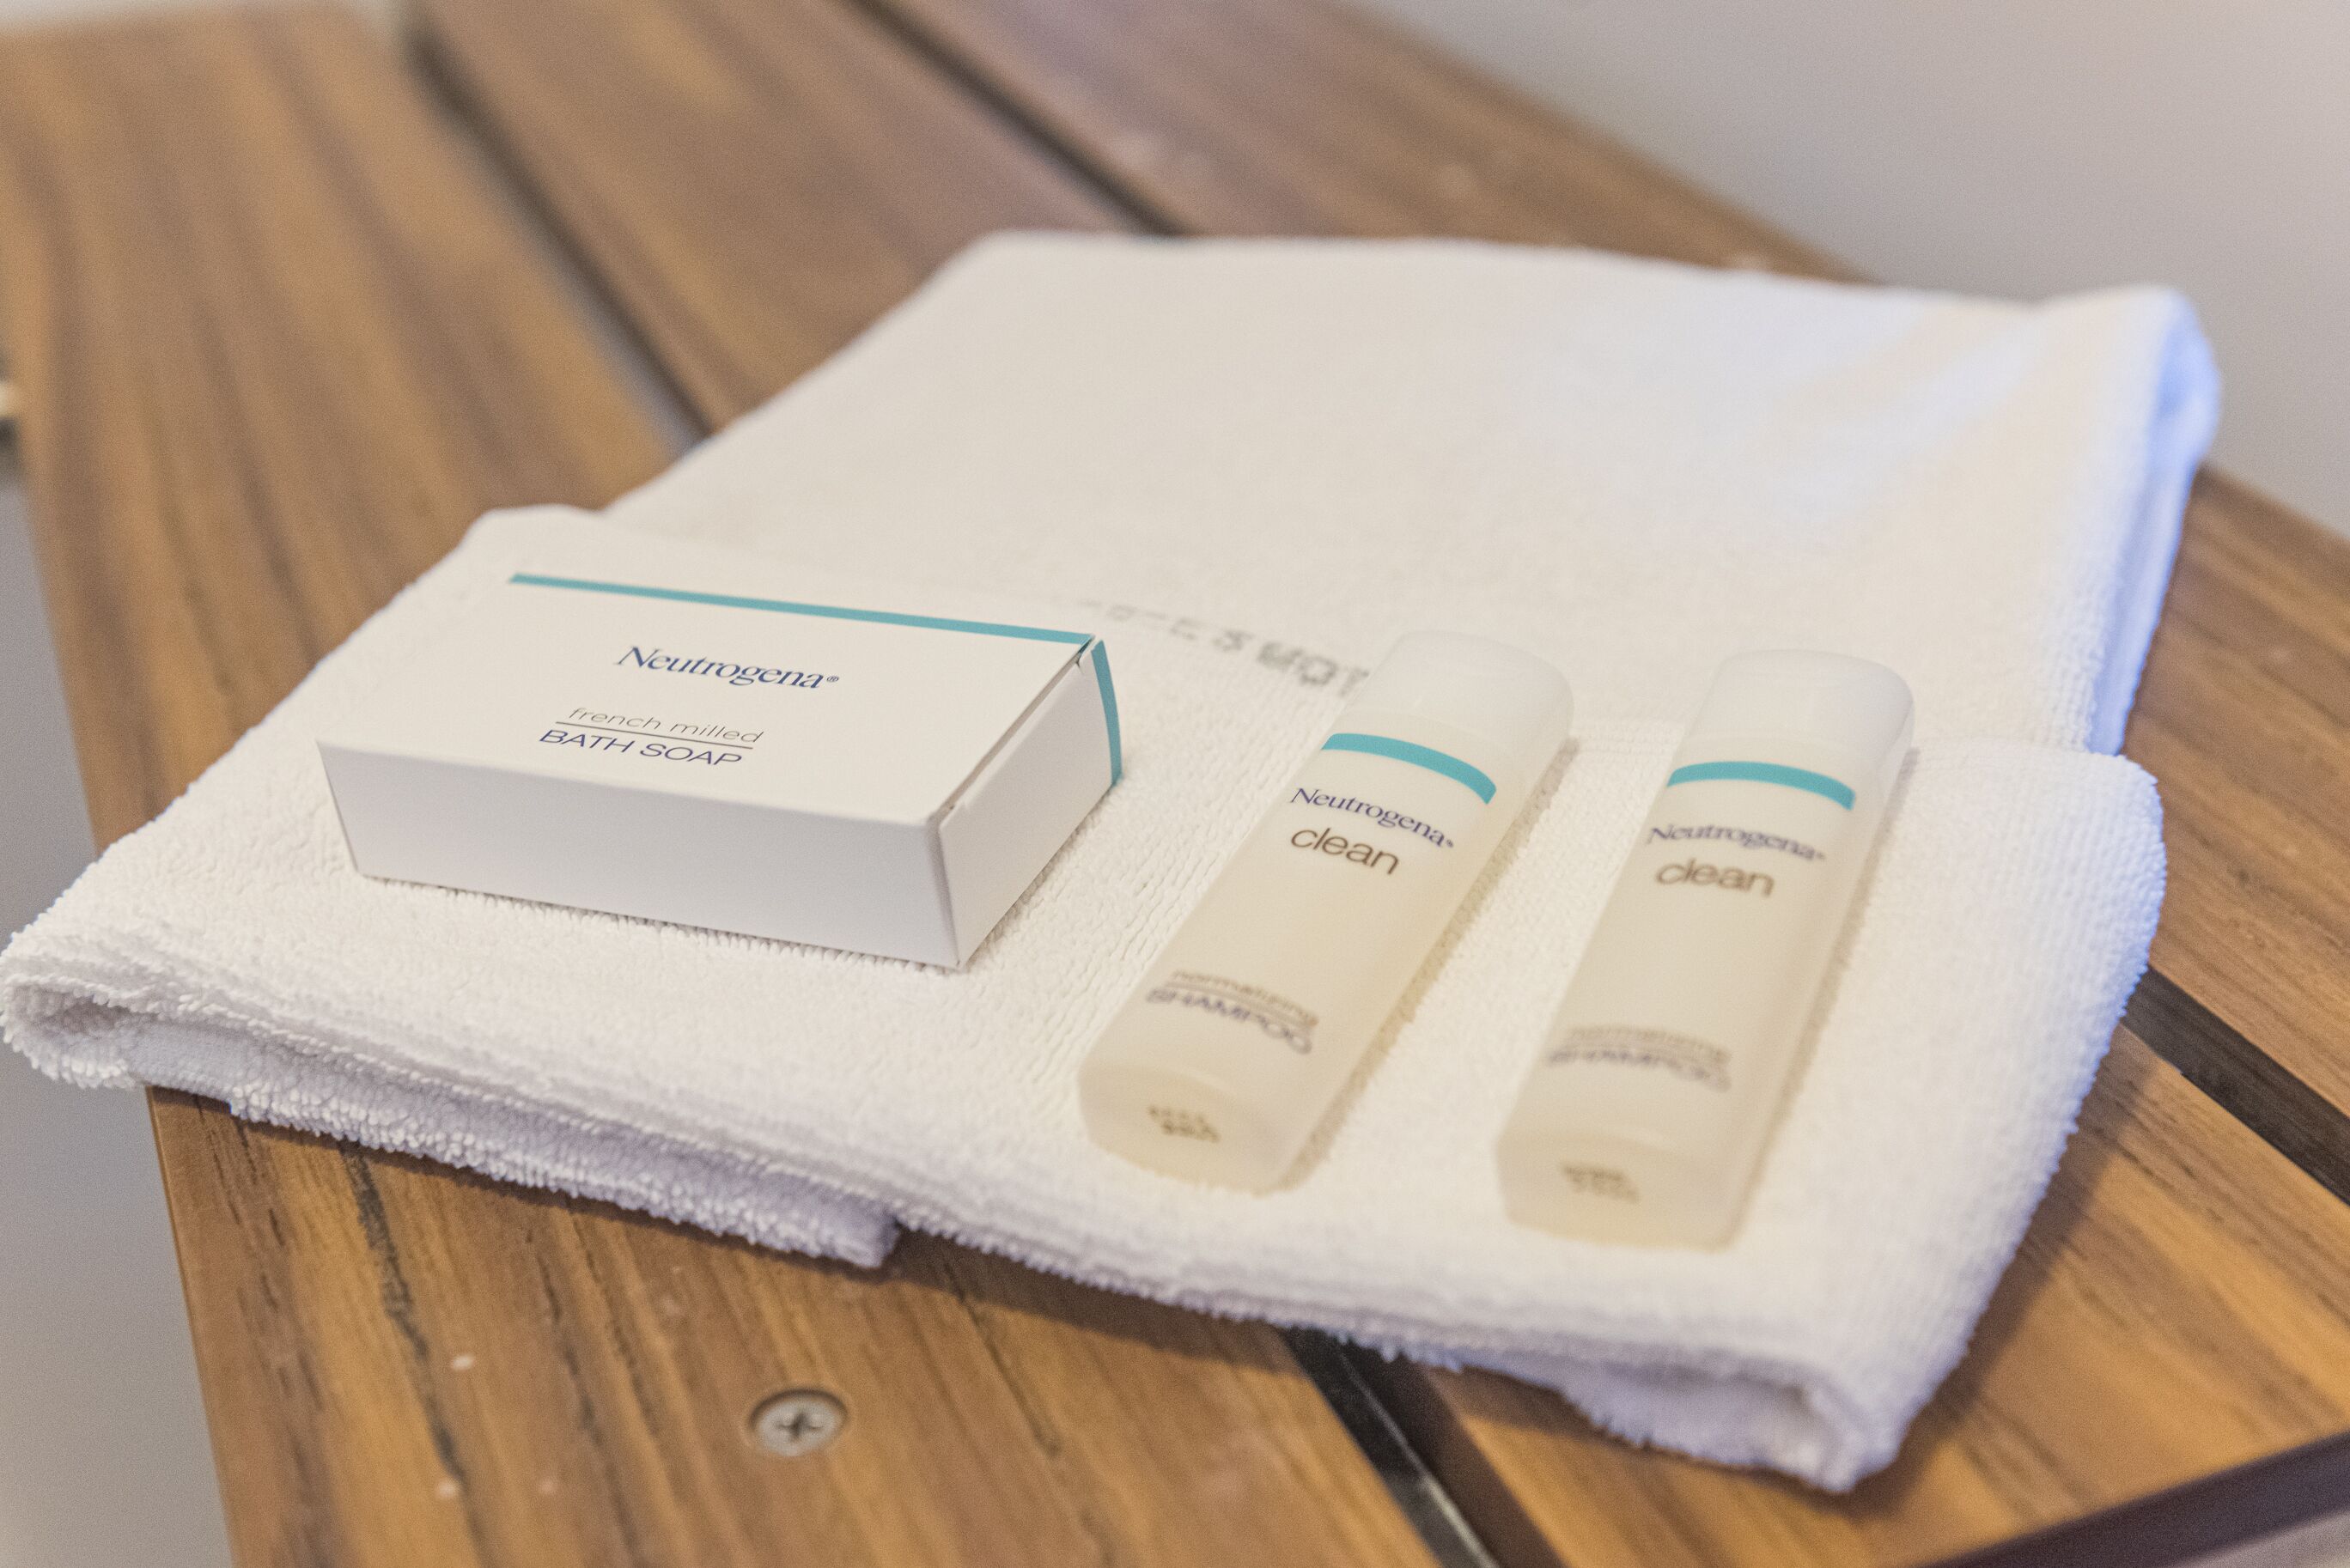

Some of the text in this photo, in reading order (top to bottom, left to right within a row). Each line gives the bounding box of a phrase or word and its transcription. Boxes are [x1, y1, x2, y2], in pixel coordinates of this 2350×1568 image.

[569, 707, 764, 744] french milled
[539, 730, 742, 766] BATH SOAP
[1290, 828, 1399, 875] clean
[1655, 859, 1775, 898] clean
[1146, 988, 1313, 1054] SHAMPOO
